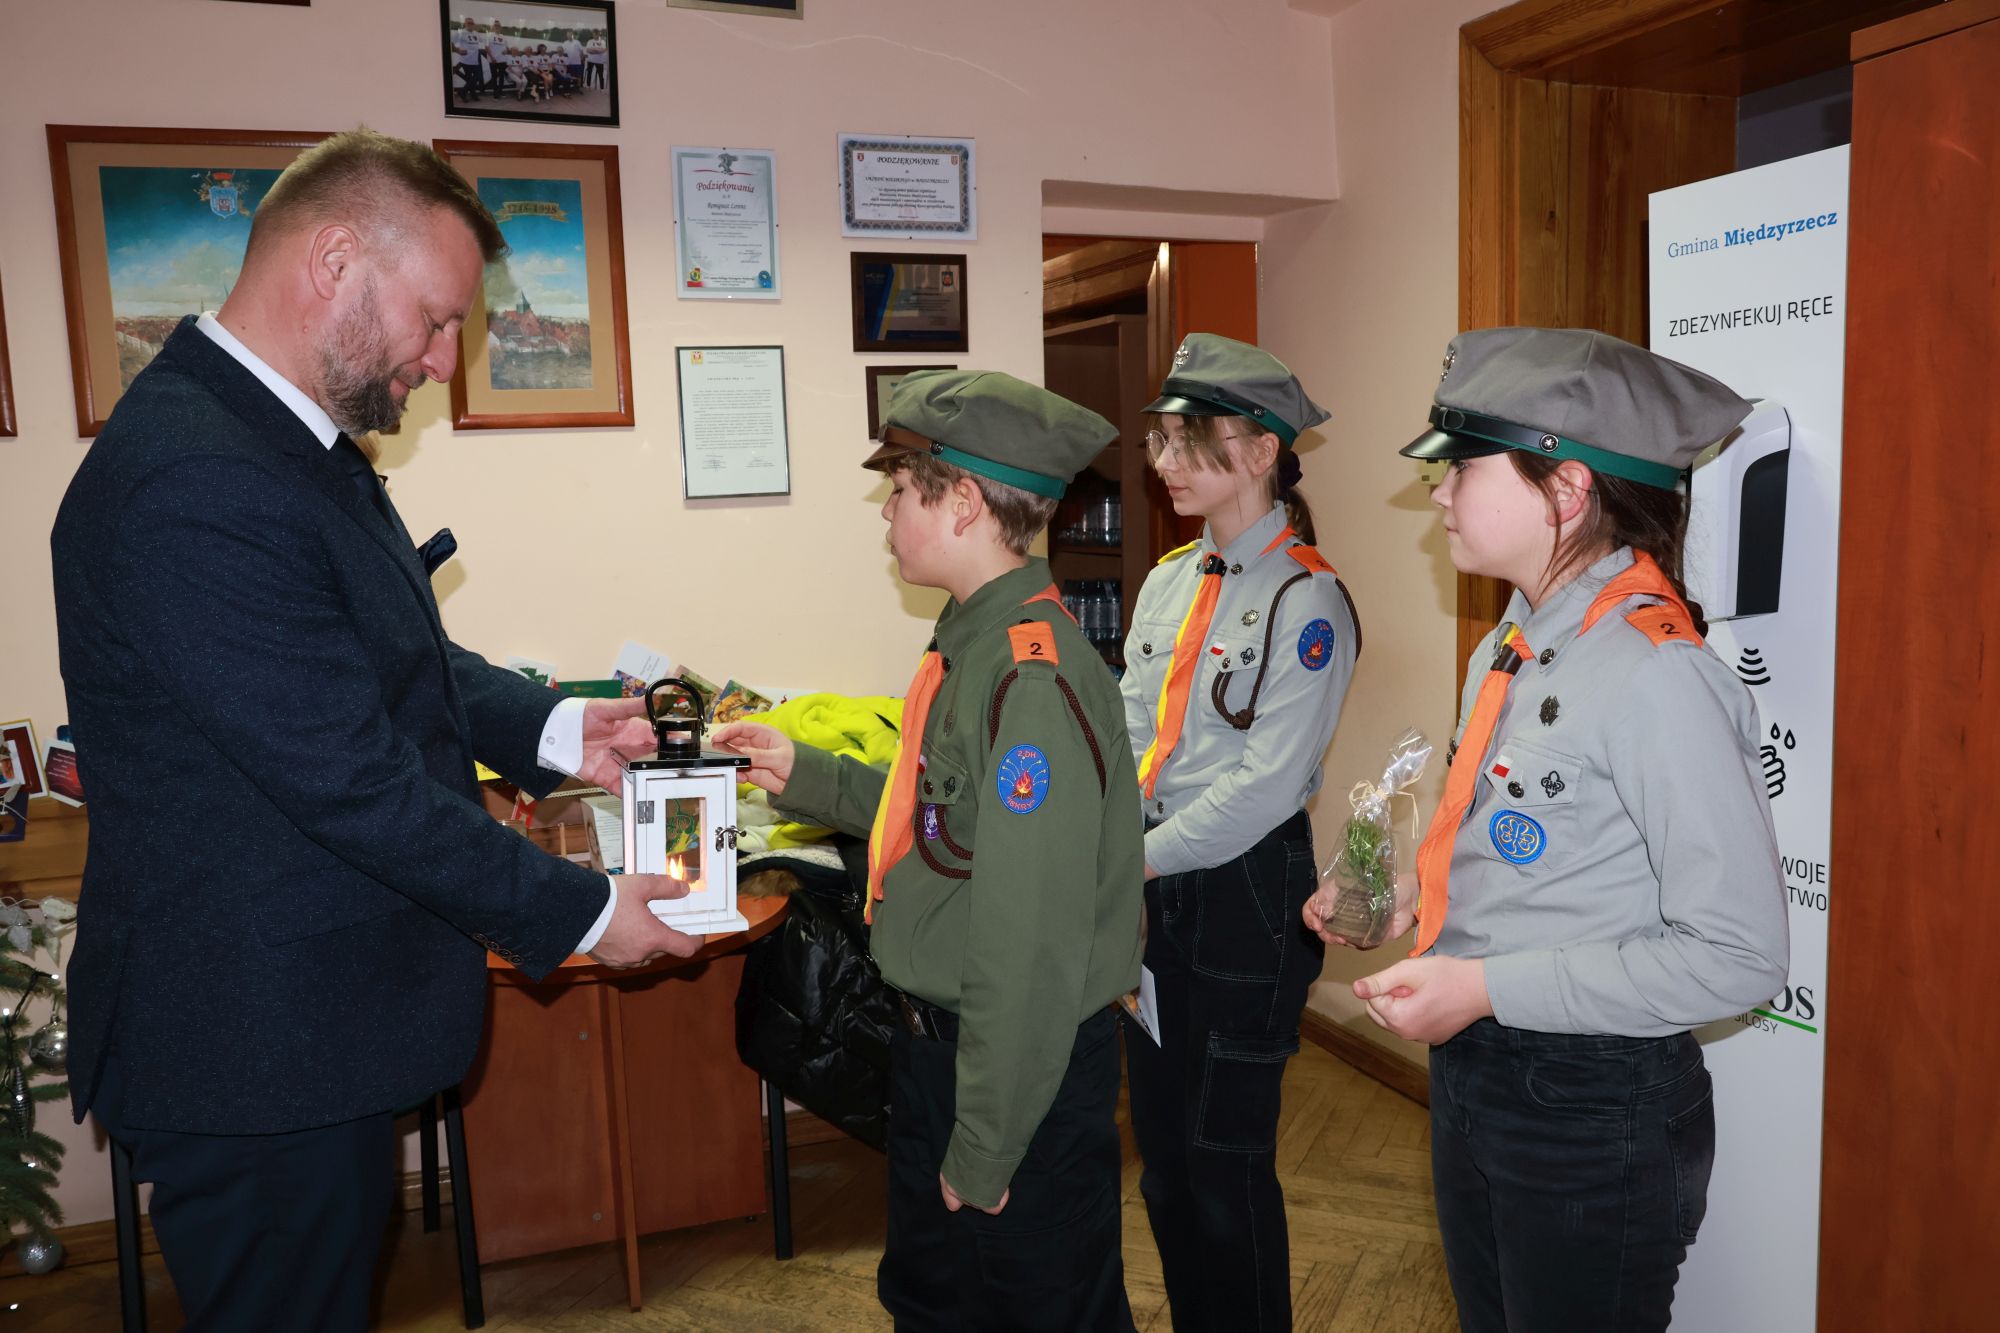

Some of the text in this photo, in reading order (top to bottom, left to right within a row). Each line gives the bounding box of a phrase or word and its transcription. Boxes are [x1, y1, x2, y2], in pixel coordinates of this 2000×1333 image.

[696, 180, 755, 193] Podziękowania
[1667, 212, 1838, 258] Gmina Międzyrzecz
[1669, 295, 1833, 337] ZDEZYNFEKUJ RĘCE
[1660, 622, 1681, 635] 2
[1030, 642, 1044, 655] 2
[1781, 856, 1826, 885] WOJE
[1786, 885, 1827, 911] TWO
[1769, 985, 1815, 1020] OS
